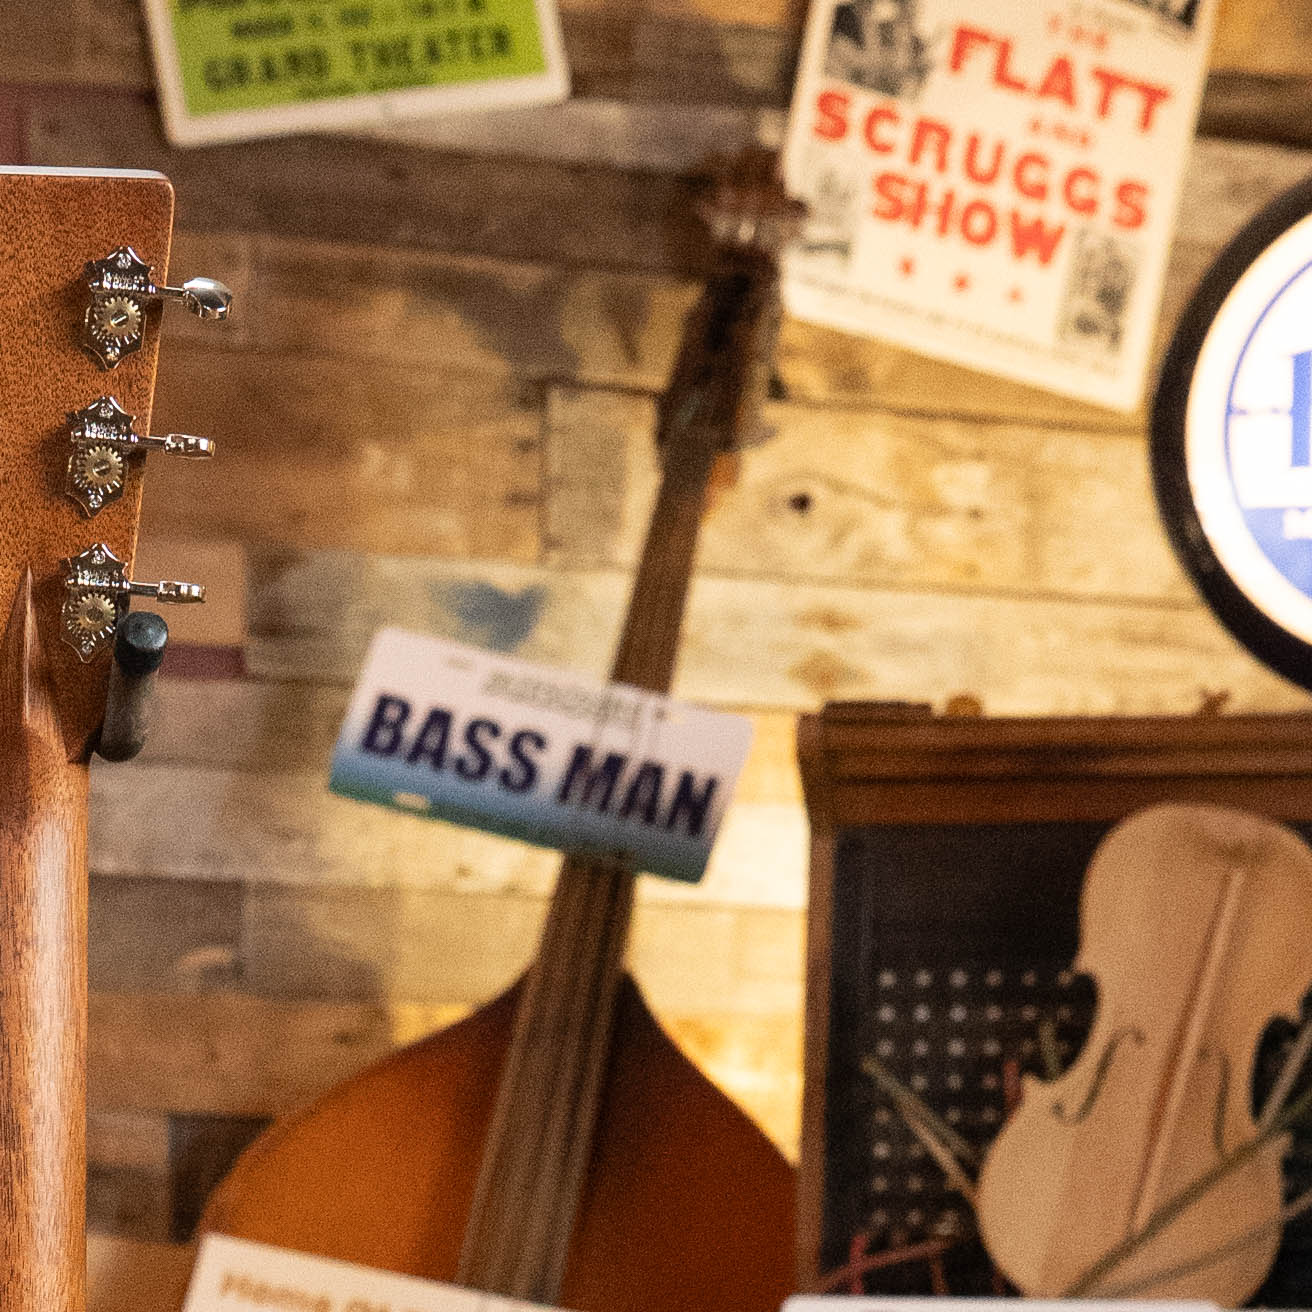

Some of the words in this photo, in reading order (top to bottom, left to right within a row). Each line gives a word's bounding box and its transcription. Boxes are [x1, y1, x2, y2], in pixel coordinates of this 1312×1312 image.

[949, 23, 1172, 133] FLATT
[812, 90, 1150, 231] SCRUGGS
[872, 172, 1066, 269] SHOW
[360, 693, 548, 794] BASS
[557, 743, 722, 838] MAN
